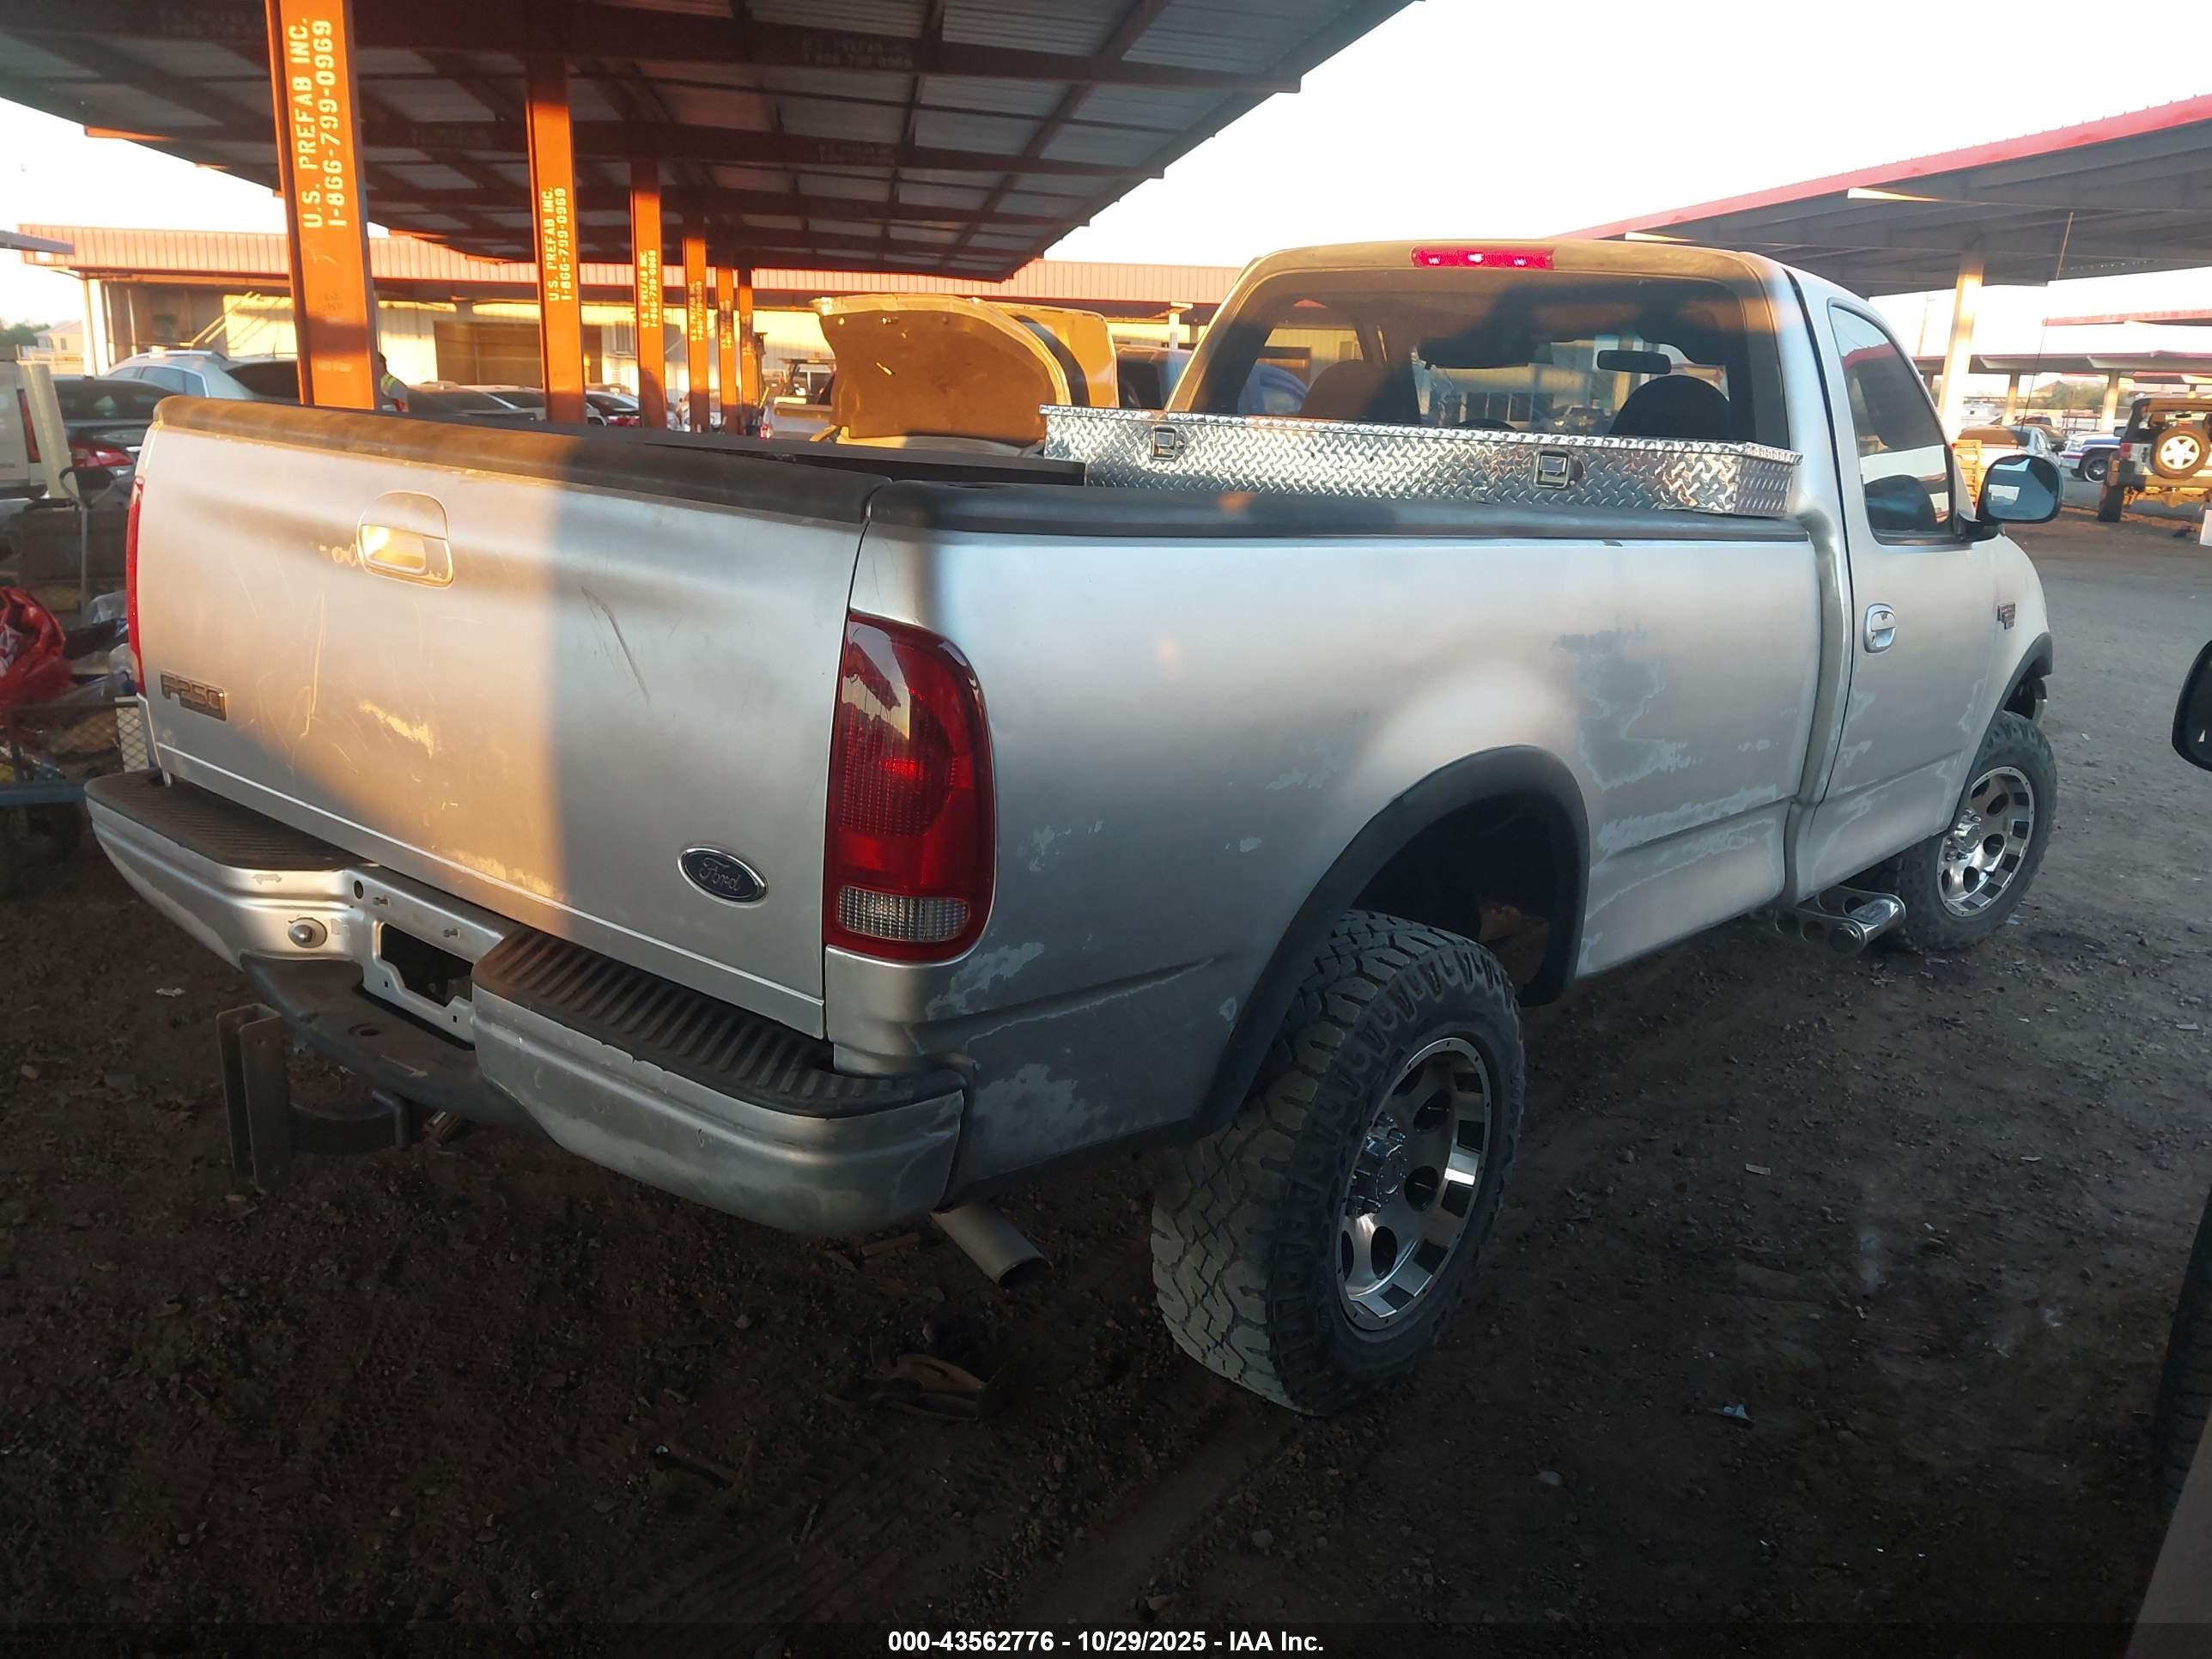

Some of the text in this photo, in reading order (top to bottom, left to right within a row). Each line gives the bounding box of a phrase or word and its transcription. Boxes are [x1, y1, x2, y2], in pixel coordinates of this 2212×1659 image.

[288, 17, 323, 228] U.S. PREFAB INC.
[312, 19, 347, 228] 1-866-799-0969
[542, 186, 559, 301] U.S. PREFAB INC.
[554, 187, 573, 301] 1-866-799-0969
[639, 270, 649, 306] PREFAB
[700, 857, 742, 891] Ford
